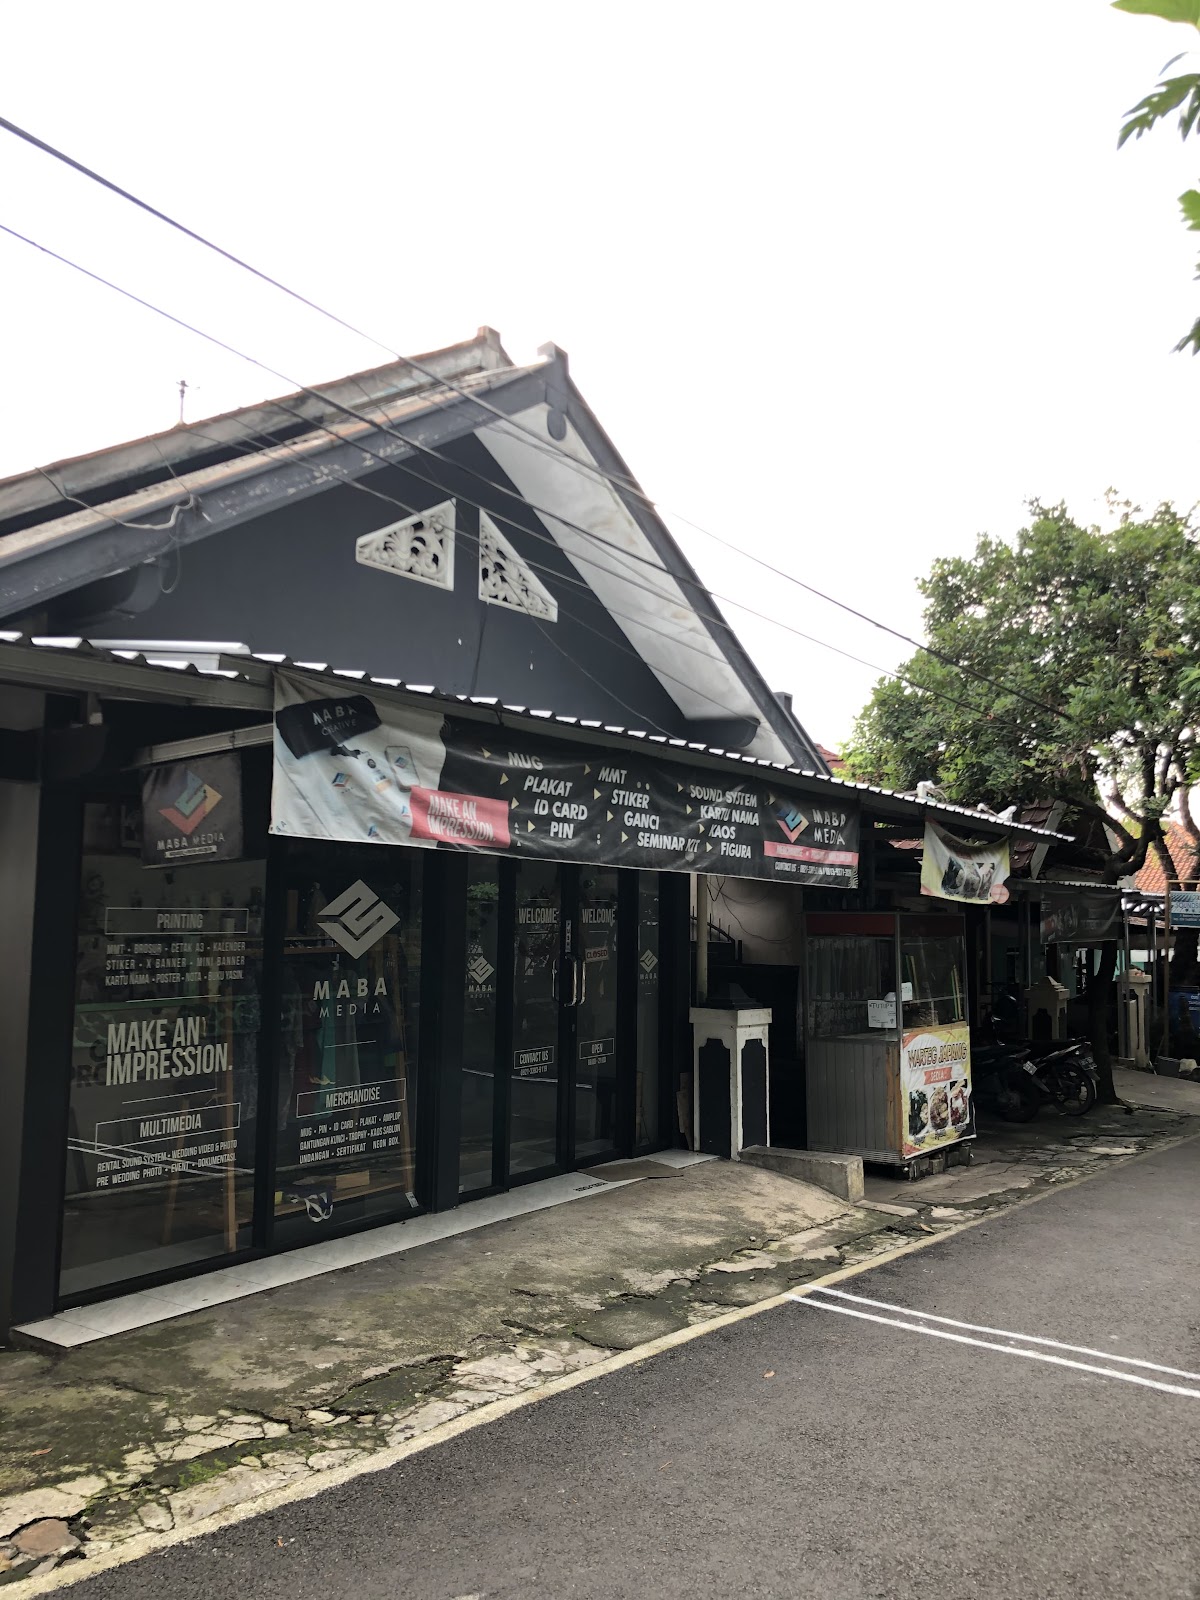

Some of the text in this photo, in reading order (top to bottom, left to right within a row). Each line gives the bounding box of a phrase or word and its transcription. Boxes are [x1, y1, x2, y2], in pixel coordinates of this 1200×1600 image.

[508, 752, 544, 771] MUG
[598, 767, 627, 785] MMT
[523, 775, 573, 798] PLAKAT
[689, 785, 758, 808] SOUND SYSTEM
[428, 795, 477, 820] MAKE AN
[611, 789, 650, 809] STIKER
[533, 799, 588, 821] ID CARD
[700, 805, 760, 826] KARTU NAMA
[427, 814, 497, 842] IMPRESSION.
[549, 821, 575, 840] PIN
[623, 811, 660, 831] GANCI
[637, 831, 700, 853] SEMINAR KIT
[708, 824, 736, 840] KAOS
[813, 827, 846, 845] MEDIA
[720, 842, 751, 859] FIGURA
[157, 913, 204, 929] PRINTING
[518, 907, 558, 924] WELCOME
[582, 908, 615, 924] WELCOME
[213, 941, 246, 952] KALENDER
[586, 949, 608, 959] CLOSED
[105, 955, 246, 971] STIKER X BANNER MINI BANNER
[105, 974, 129, 986] KARTU
[129, 973, 150, 985] NAMA
[155, 973, 181, 984] POSTER
[313, 977, 388, 1001] MABA
[468, 984, 493, 992] MABA
[319, 1002, 381, 1019] MEDIA
[107, 1016, 200, 1055] MAKE AN
[105, 1042, 233, 1087] IMPRESSION.
[519, 1050, 549, 1065] CONTACT US
[325, 1086, 380, 1109] MERCHANDISE
[139, 1113, 202, 1138] MULTIMEDIA
[300, 1127, 312, 1138] MUG
[318, 1124, 328, 1134] PIN
[333, 1122, 339, 1132] ID
[340, 1119, 354, 1130] CARD
[359, 1115, 378, 1127] PLAKAT
[348, 1130, 368, 1141] TROPHY
[97, 1160, 121, 1173] RENTAL
[122, 1157, 142, 1170] SOUND
[171, 1147, 198, 1159] WEDDING
[198, 1143, 214, 1155] VIDEO
[219, 1139, 237, 1151] PHOTO
[299, 1150, 330, 1164] UNDANGAN
[336, 1142, 367, 1157] SERTIFIKAT
[372, 1139, 387, 1150] NEON
[96, 1176, 109, 1188] PRE
[111, 1170, 140, 1184] WEDDING
[142, 1166, 163, 1179] PHOTO
